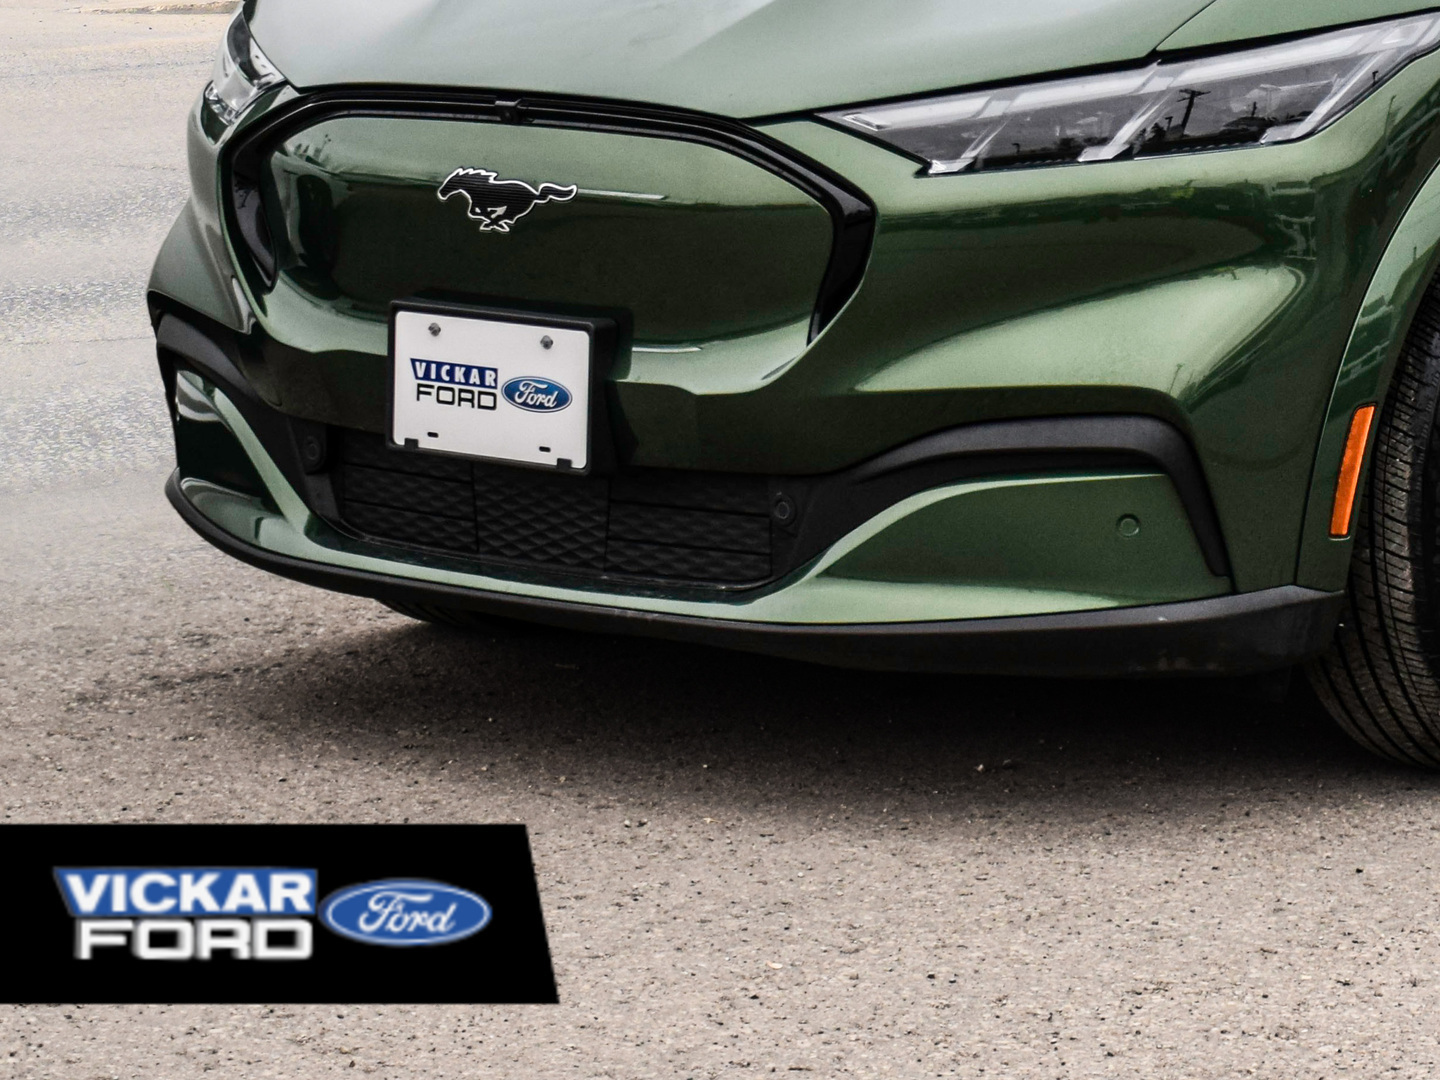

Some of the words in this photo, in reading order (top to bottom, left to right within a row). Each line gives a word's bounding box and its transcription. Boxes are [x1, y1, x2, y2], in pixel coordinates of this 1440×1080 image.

[414, 360, 498, 388] VICKAR
[416, 382, 498, 411] FORD
[514, 380, 560, 408] Ford
